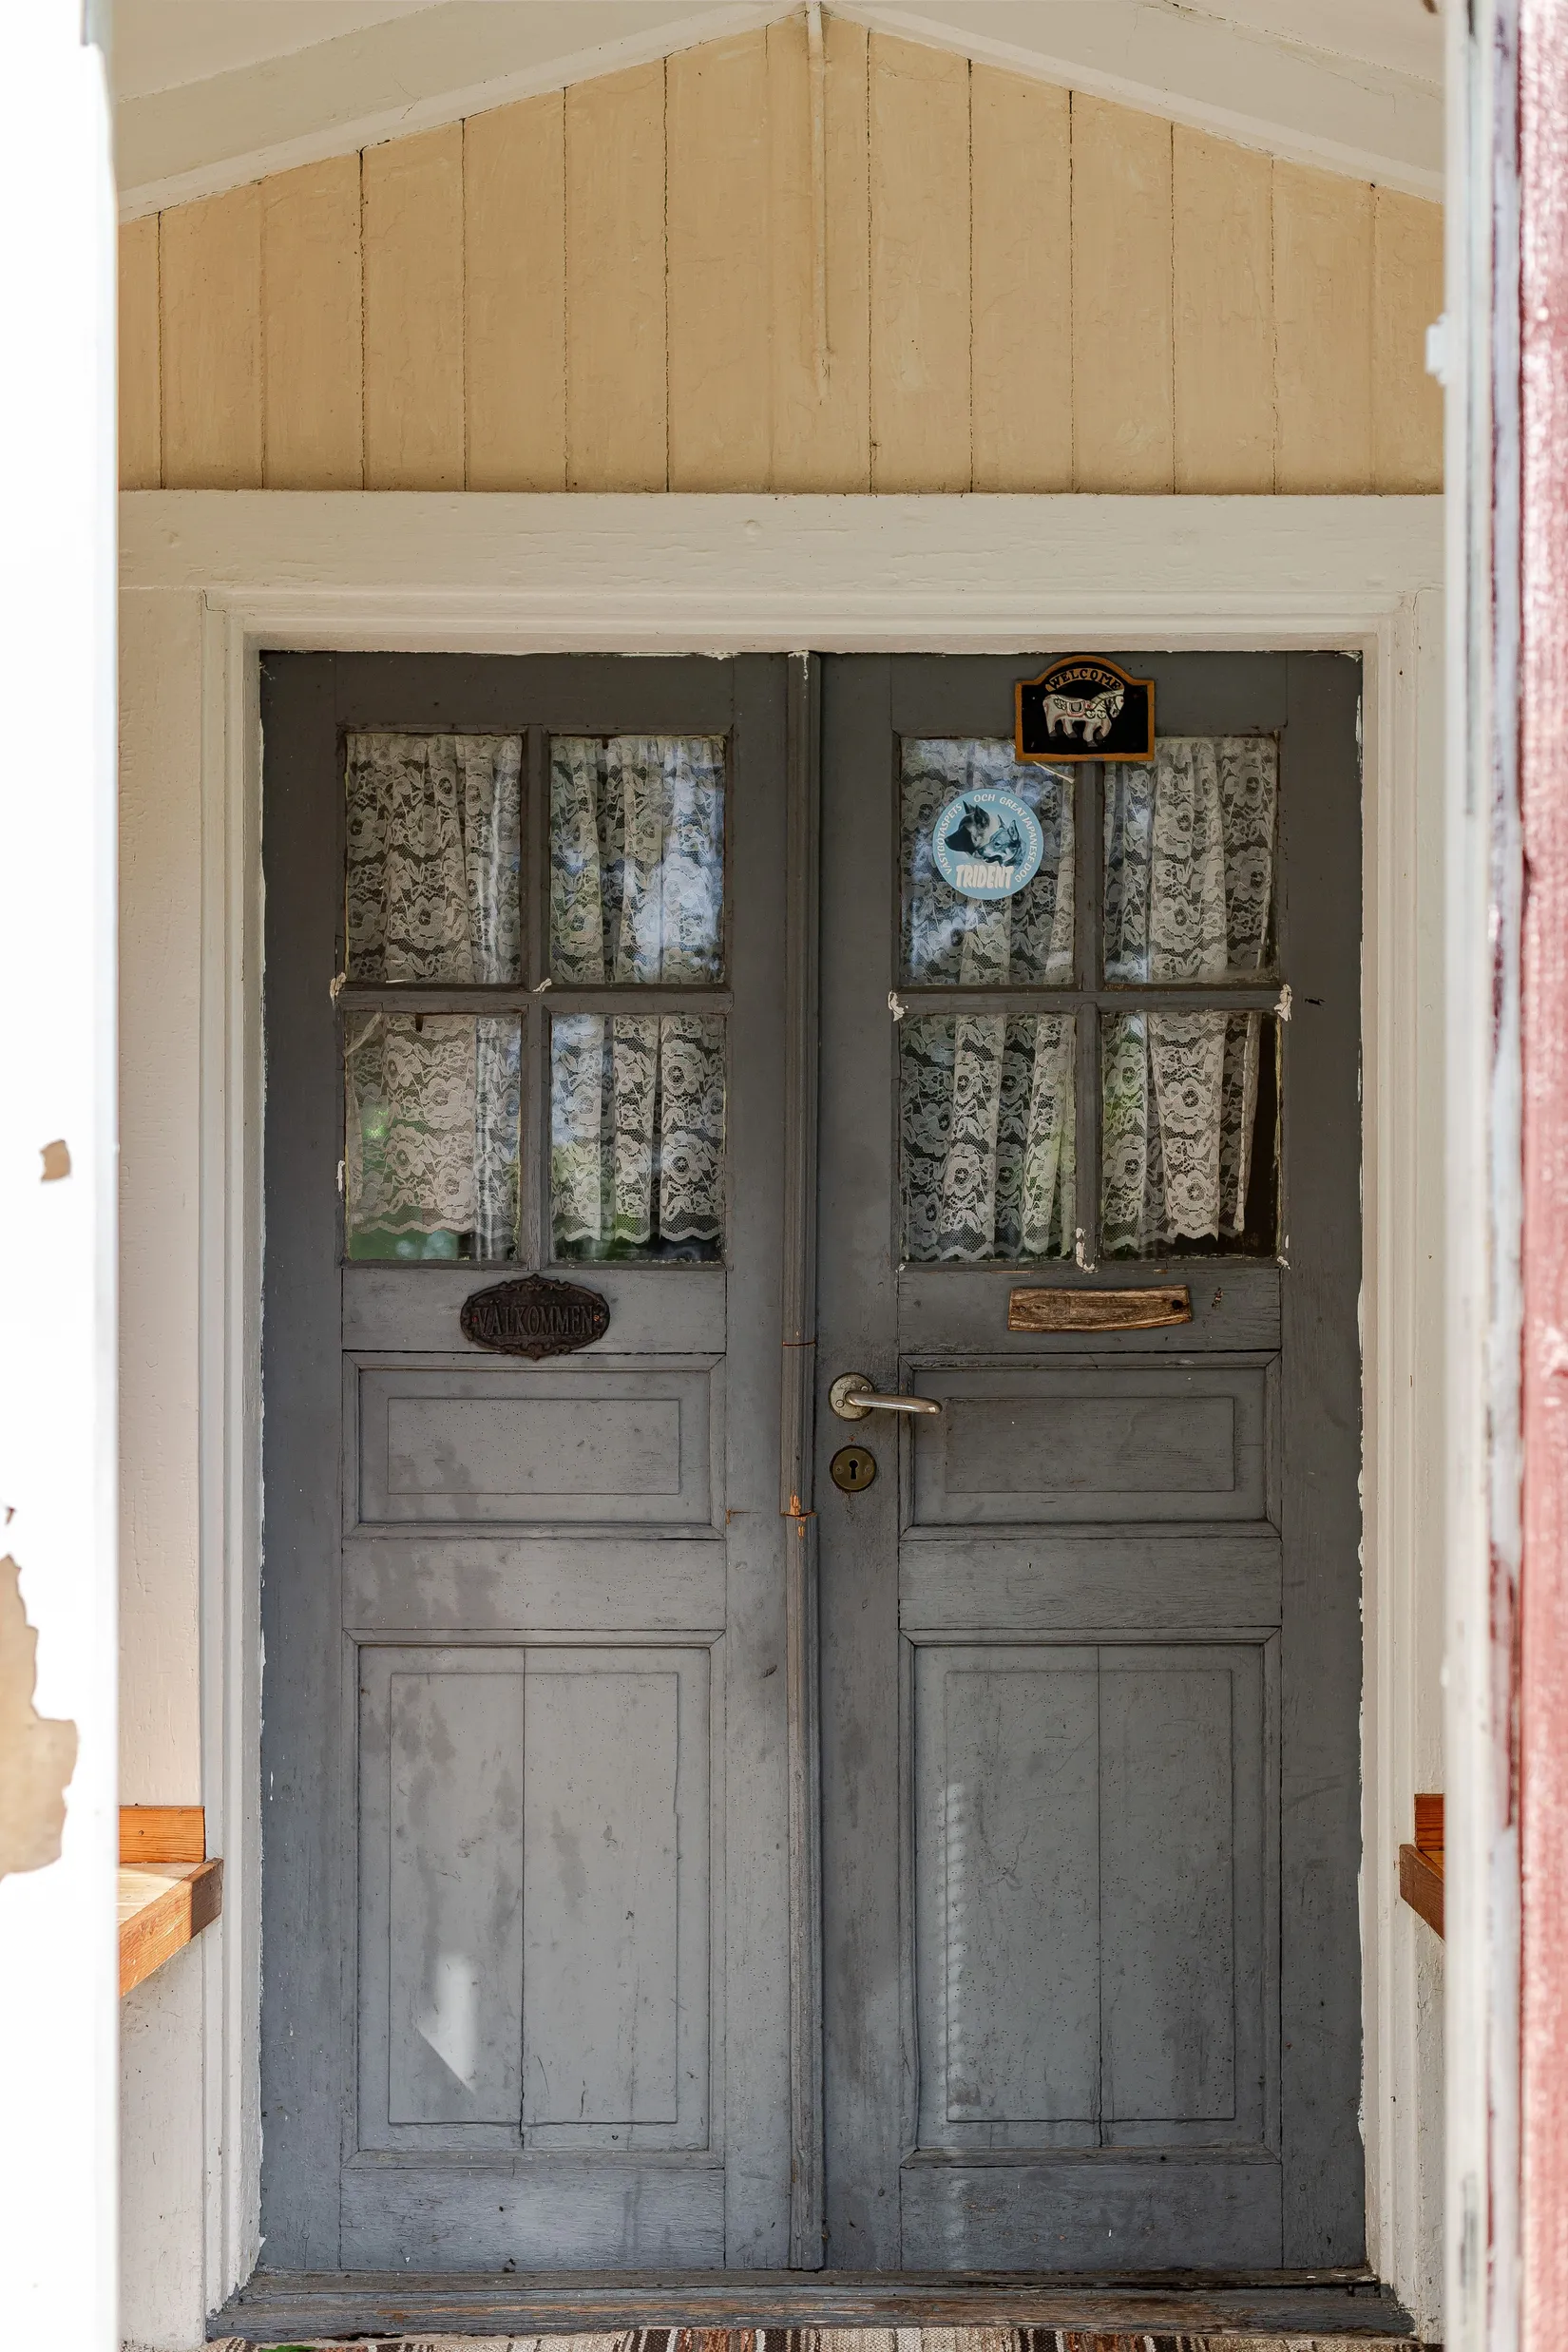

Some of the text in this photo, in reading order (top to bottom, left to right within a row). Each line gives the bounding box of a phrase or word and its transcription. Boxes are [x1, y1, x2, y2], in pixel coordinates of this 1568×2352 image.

[1049, 669, 1122, 690] WELCOME
[973, 794, 996, 803] OCH
[999, 796, 1026, 817] GREAT
[1022, 817, 1038, 863] JAPANESE
[955, 864, 1015, 889] TRIDENT
[1014, 865, 1032, 883] DOG
[475, 1299, 595, 1336] VÄLKOMMEN
